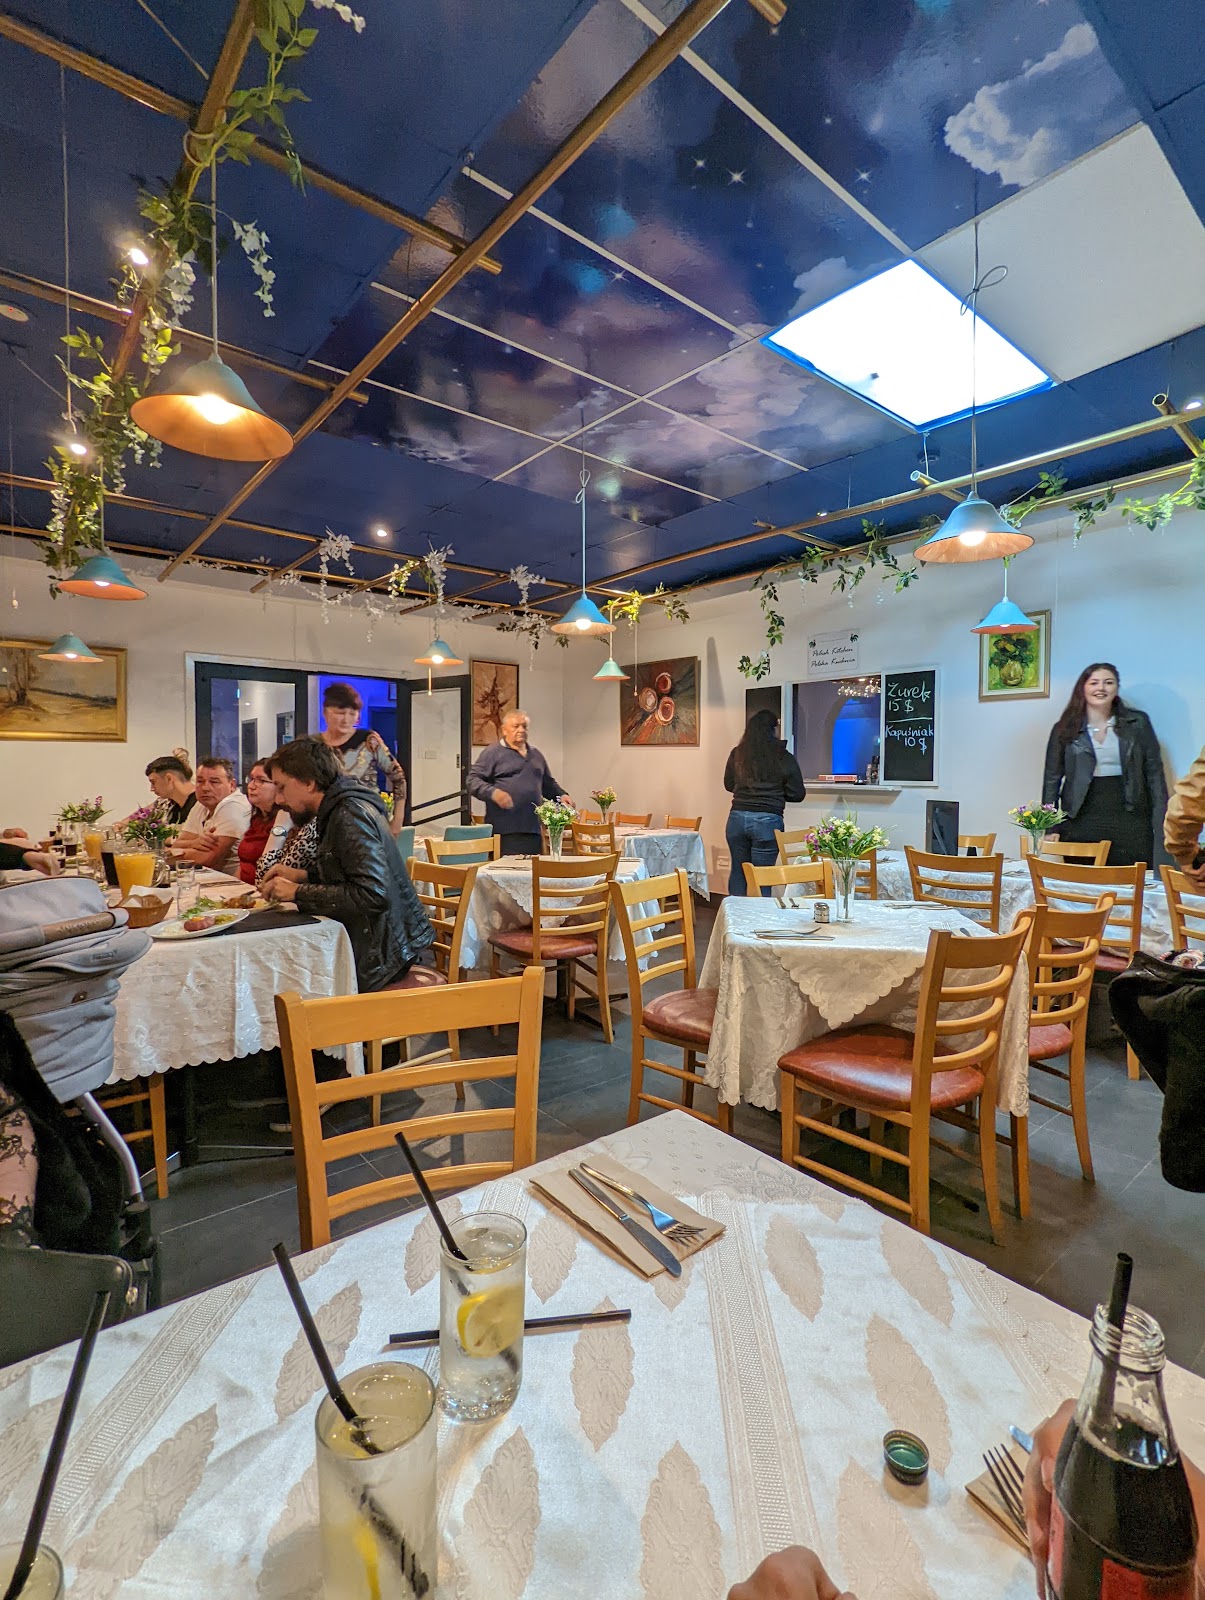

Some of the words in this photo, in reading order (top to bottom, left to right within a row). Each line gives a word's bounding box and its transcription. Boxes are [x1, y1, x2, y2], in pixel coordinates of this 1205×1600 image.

[888, 698, 902, 712] 15
[904, 698, 914, 714] $
[904, 736, 916, 747] 10
[918, 737, 928, 755] $
